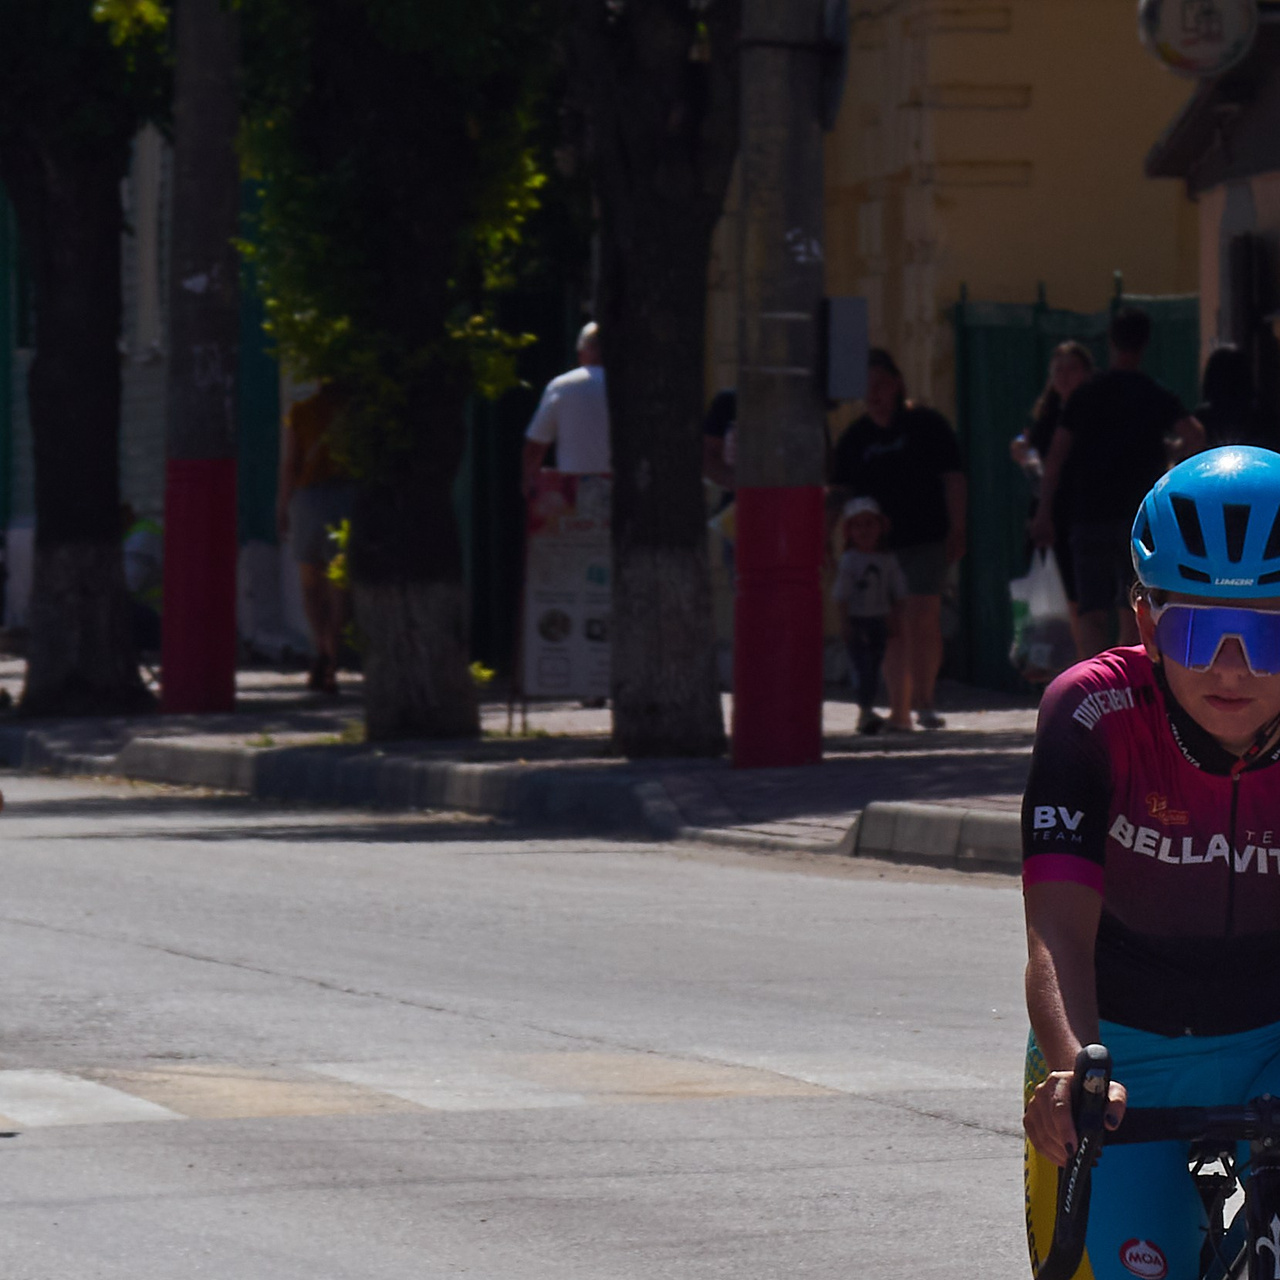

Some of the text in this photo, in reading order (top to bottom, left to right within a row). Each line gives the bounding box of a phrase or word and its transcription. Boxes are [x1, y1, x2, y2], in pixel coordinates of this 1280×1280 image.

[1033, 805, 1085, 831] BV
[1032, 831, 1083, 844] TEAM
[1128, 1252, 1163, 1267] MOA
